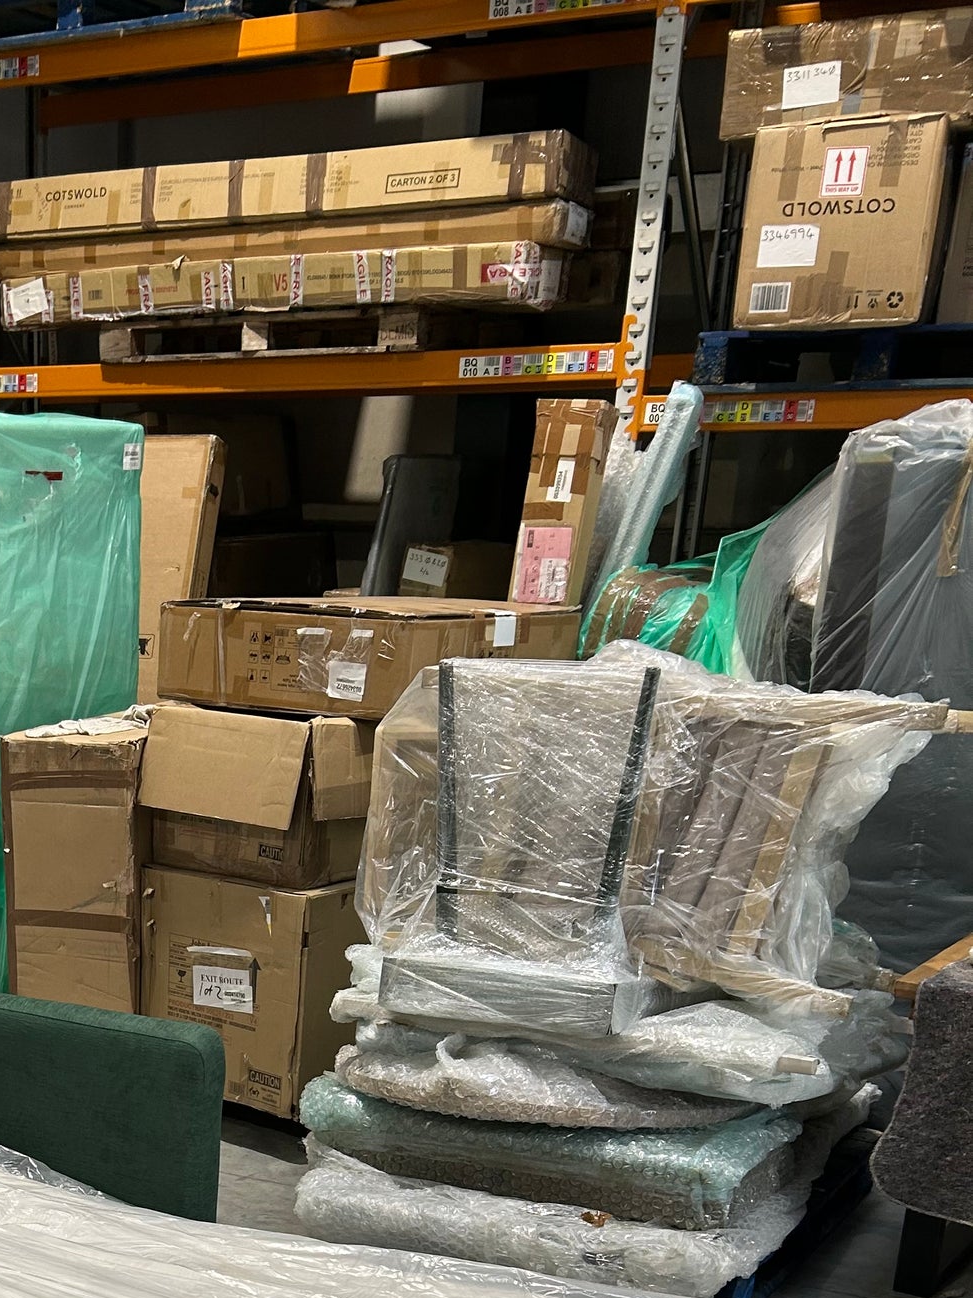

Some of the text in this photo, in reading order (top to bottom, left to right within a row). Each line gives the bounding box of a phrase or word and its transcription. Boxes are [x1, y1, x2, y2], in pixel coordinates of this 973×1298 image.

[493, 7, 509, 17] 008
[515, 6, 522, 14] A
[390, 173, 456, 188] CARTON 2 OF 3
[45, 186, 107, 202] COTSWOLD
[782, 198, 896, 217] COTSWOLD
[761, 228, 815, 242] 3346994
[274, 274, 288, 291] V5
[464, 358, 477, 367] BQ
[505, 356, 511, 364] B
[547, 354, 554, 362] D
[463, 364, 573, 376] 010 A C E
[650, 404, 665, 413] BQ
[200, 974, 244, 986] EXIT ROUTE
[215, 986, 223, 1000] 2
[250, 1071, 280, 1089] CAUTION
